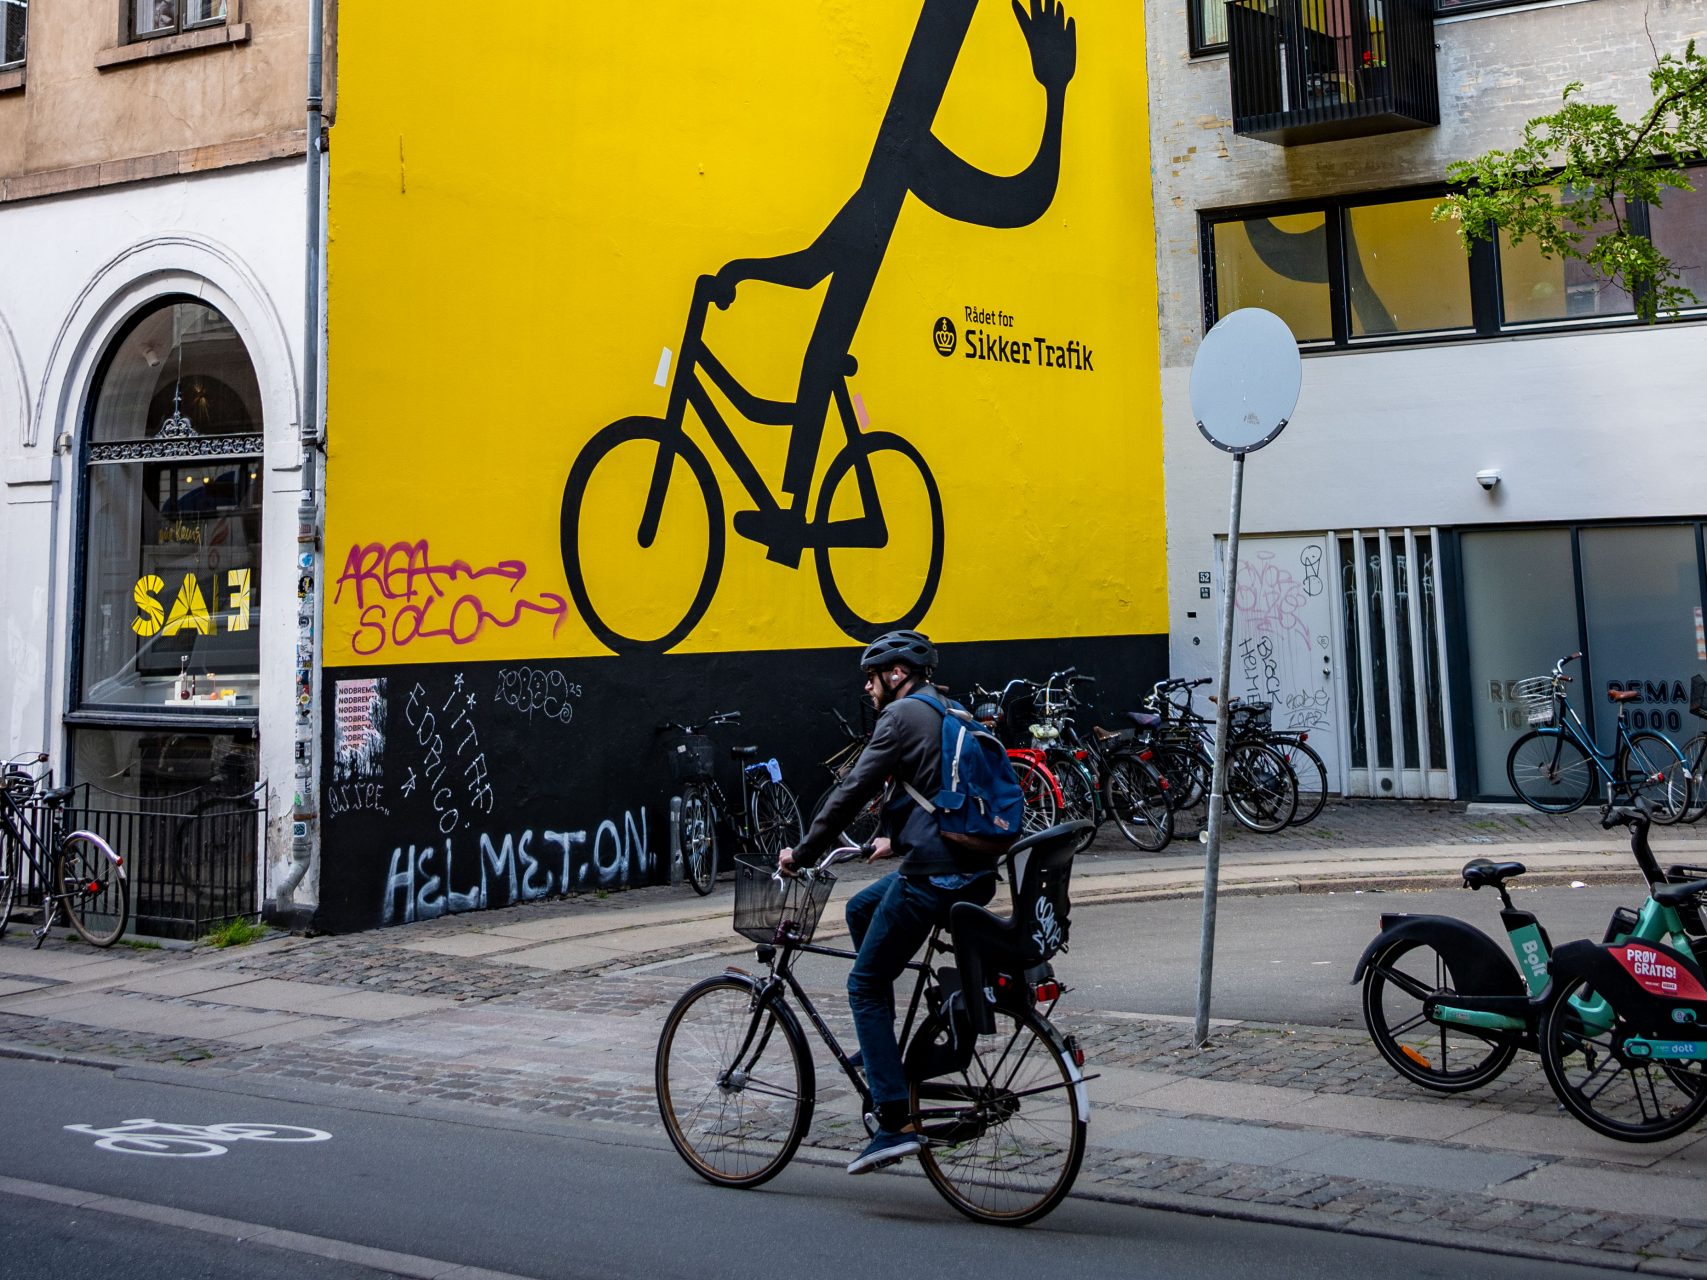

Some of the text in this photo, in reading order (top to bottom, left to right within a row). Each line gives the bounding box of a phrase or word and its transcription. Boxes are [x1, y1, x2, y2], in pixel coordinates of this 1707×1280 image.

[965, 306, 1014, 327] Rådet for
[1200, 572, 1210, 581] 52
[1626, 948, 1657, 963] PRØV
[1634, 962, 1677, 979] GRATIS!
[1671, 1044, 1694, 1053] dott
